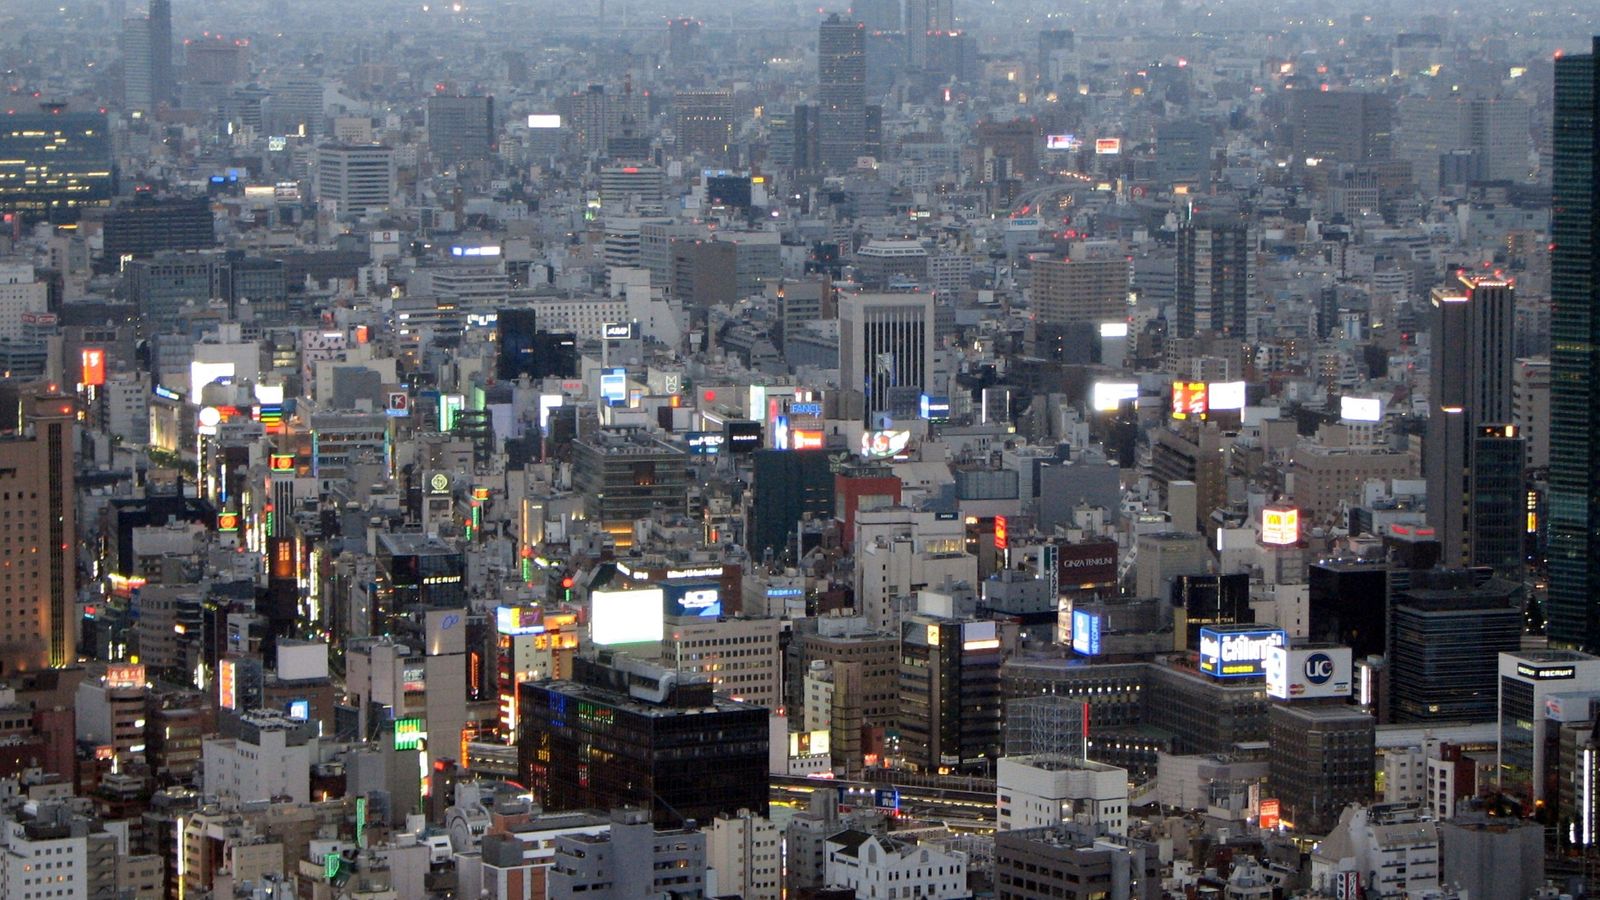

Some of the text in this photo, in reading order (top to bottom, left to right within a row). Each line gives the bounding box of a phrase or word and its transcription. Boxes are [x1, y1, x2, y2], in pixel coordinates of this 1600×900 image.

[1064, 558, 1112, 568] GINZA TENKUNI
[423, 576, 461, 584] RECRUIT
[678, 590, 718, 604] JCB
[1305, 661, 1332, 677] UC
[1539, 669, 1573, 677] RECRUIT
